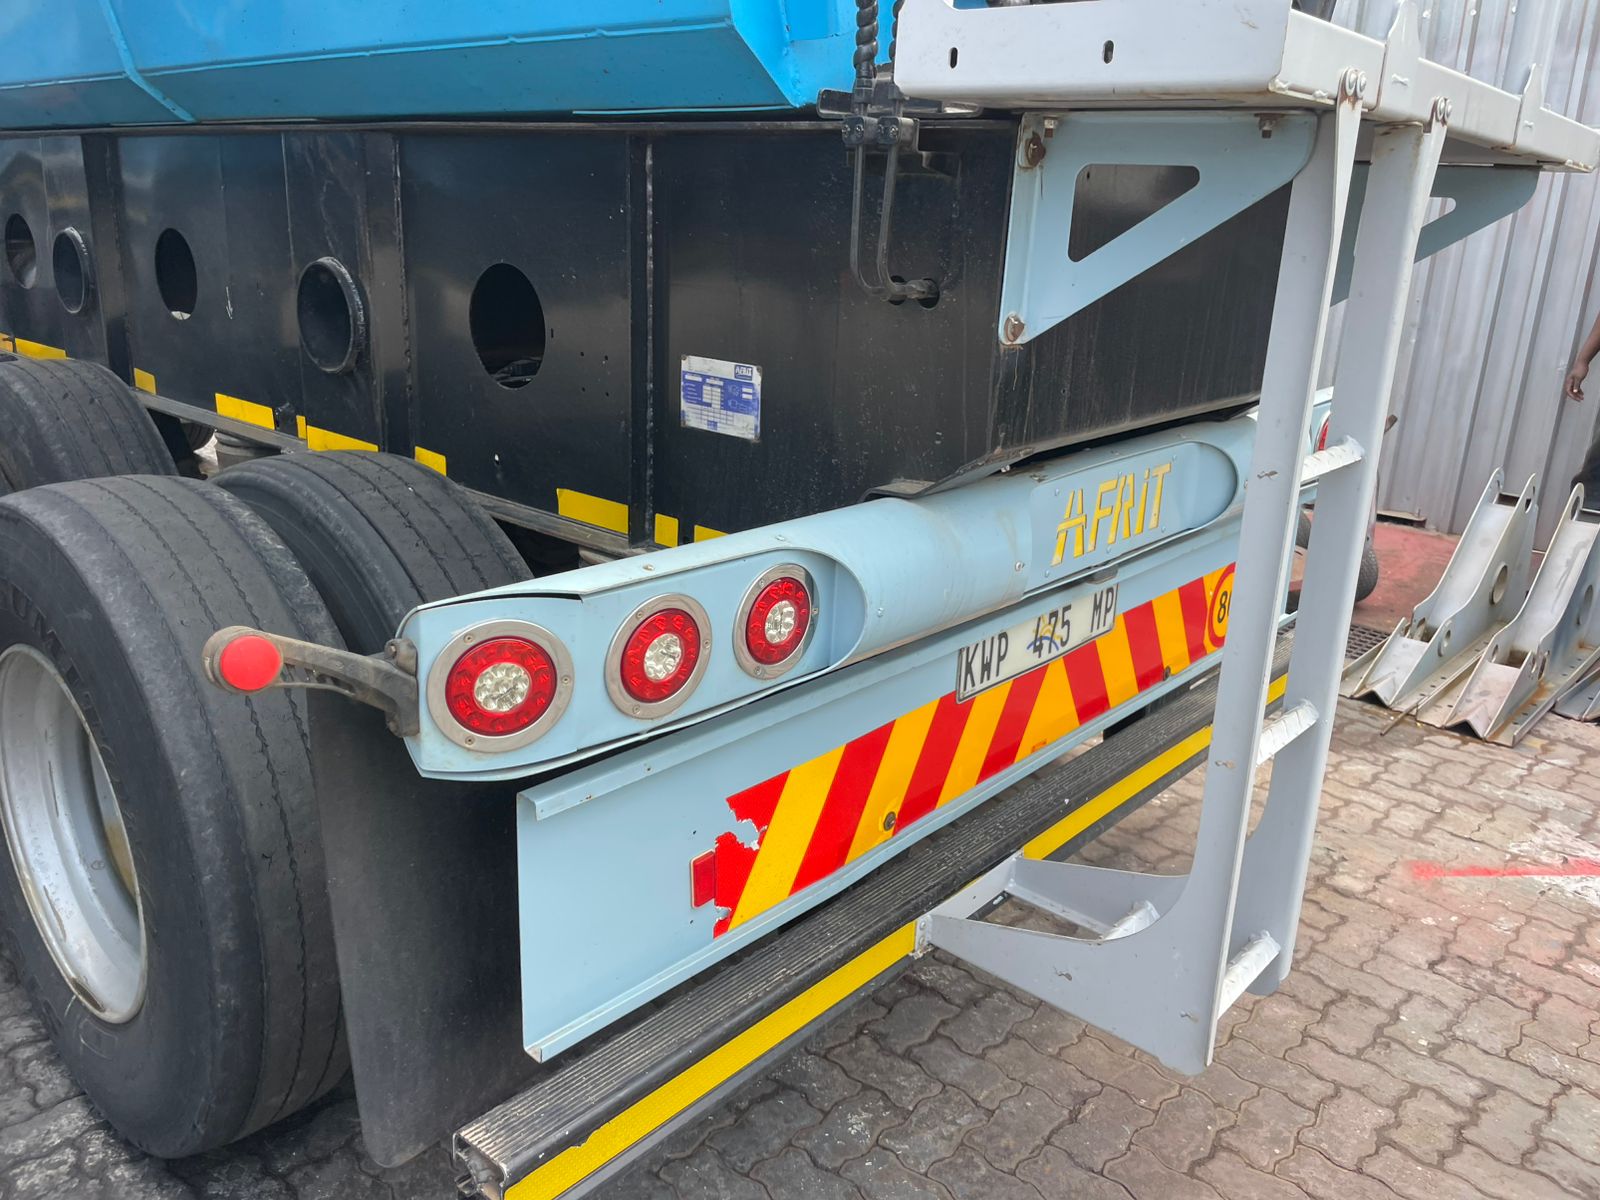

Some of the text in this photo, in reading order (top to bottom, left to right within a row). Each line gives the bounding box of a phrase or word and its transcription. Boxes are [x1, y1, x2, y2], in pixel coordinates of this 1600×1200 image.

[963, 587, 1115, 692] KWP 475 MP
